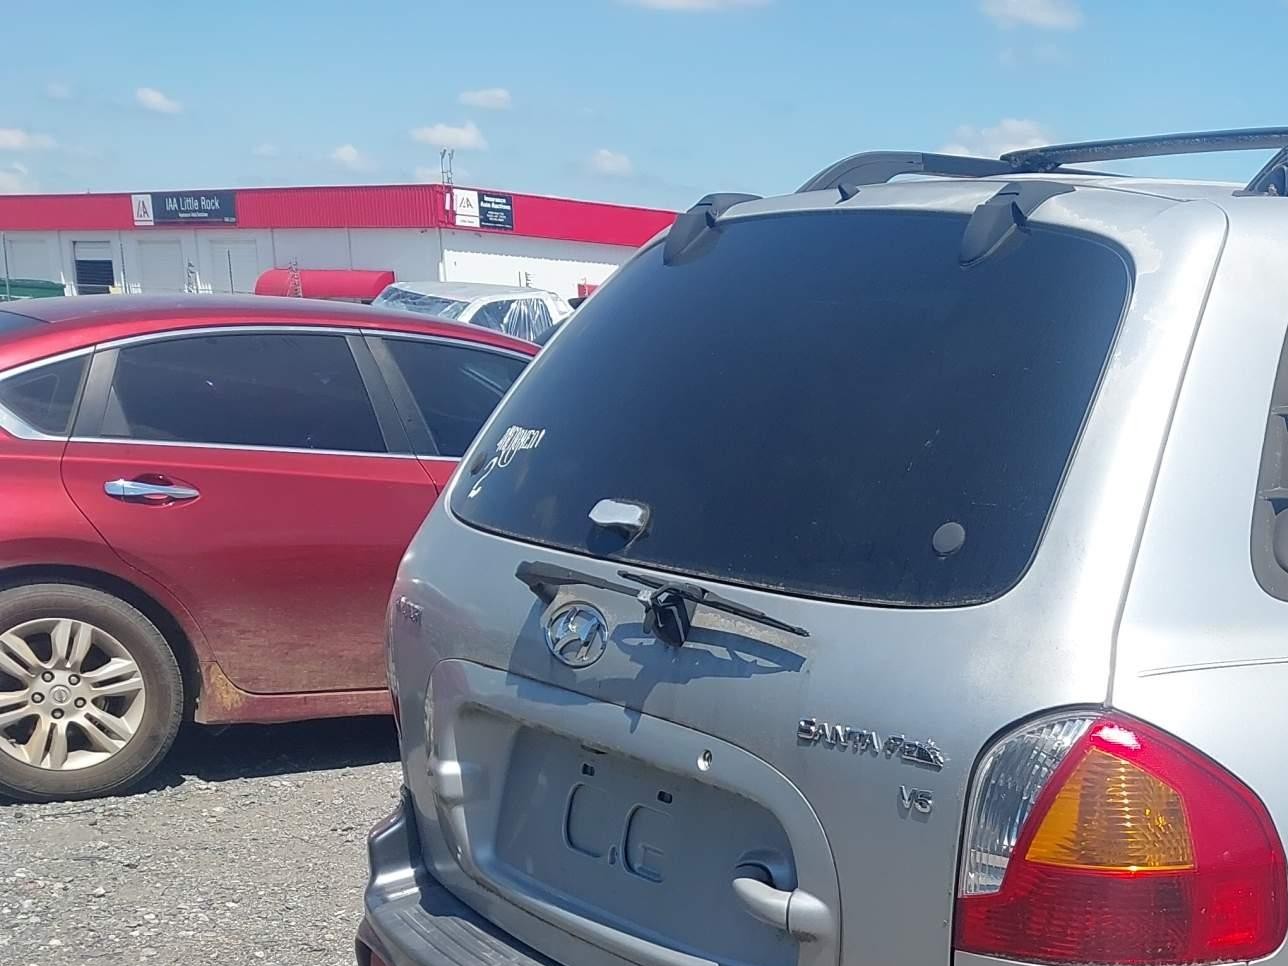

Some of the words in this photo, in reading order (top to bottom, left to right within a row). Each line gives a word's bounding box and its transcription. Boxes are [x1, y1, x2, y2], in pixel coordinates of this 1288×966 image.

[165, 198, 178, 211] IAA
[179, 197, 199, 211] Little
[200, 196, 220, 210] Rock
[797, 717, 879, 753] SANTA
[900, 785, 934, 813] V6
